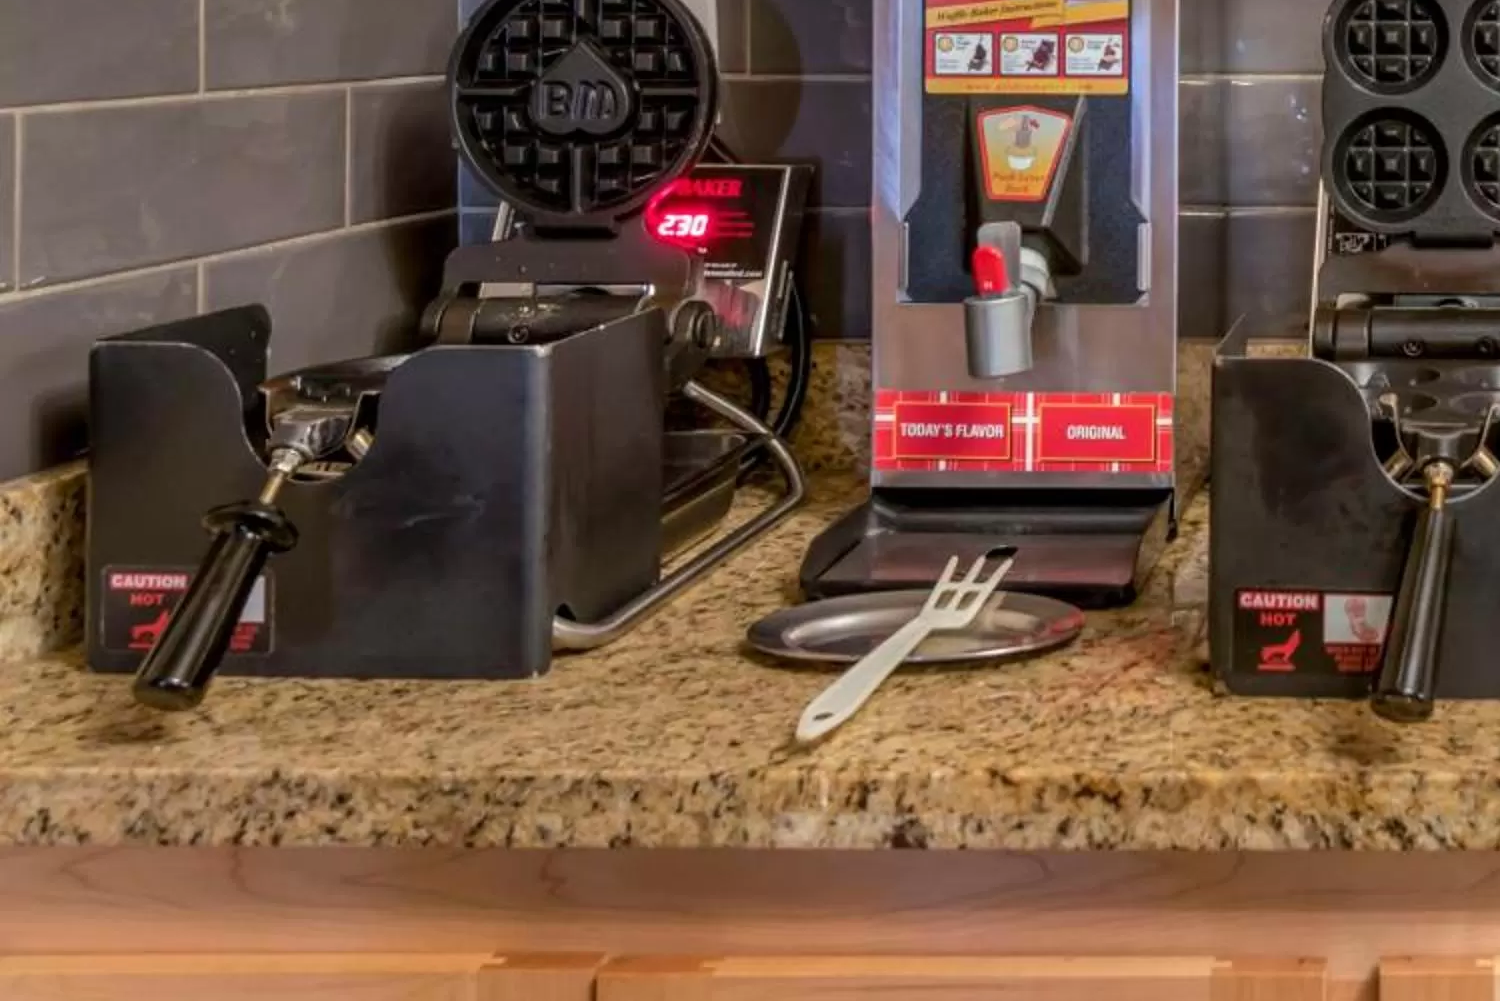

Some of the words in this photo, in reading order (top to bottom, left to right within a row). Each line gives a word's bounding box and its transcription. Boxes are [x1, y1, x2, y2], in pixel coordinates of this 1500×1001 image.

[657, 214, 709, 237] 230
[900, 422, 953, 438] TODAY'S
[955, 423, 1005, 439] FLAVOR
[1066, 425, 1127, 440] ORIGINAL
[110, 574, 188, 590] CAUTION
[129, 593, 164, 606] HOT
[1239, 592, 1320, 610] CAUTION
[1260, 612, 1297, 627] HOT
